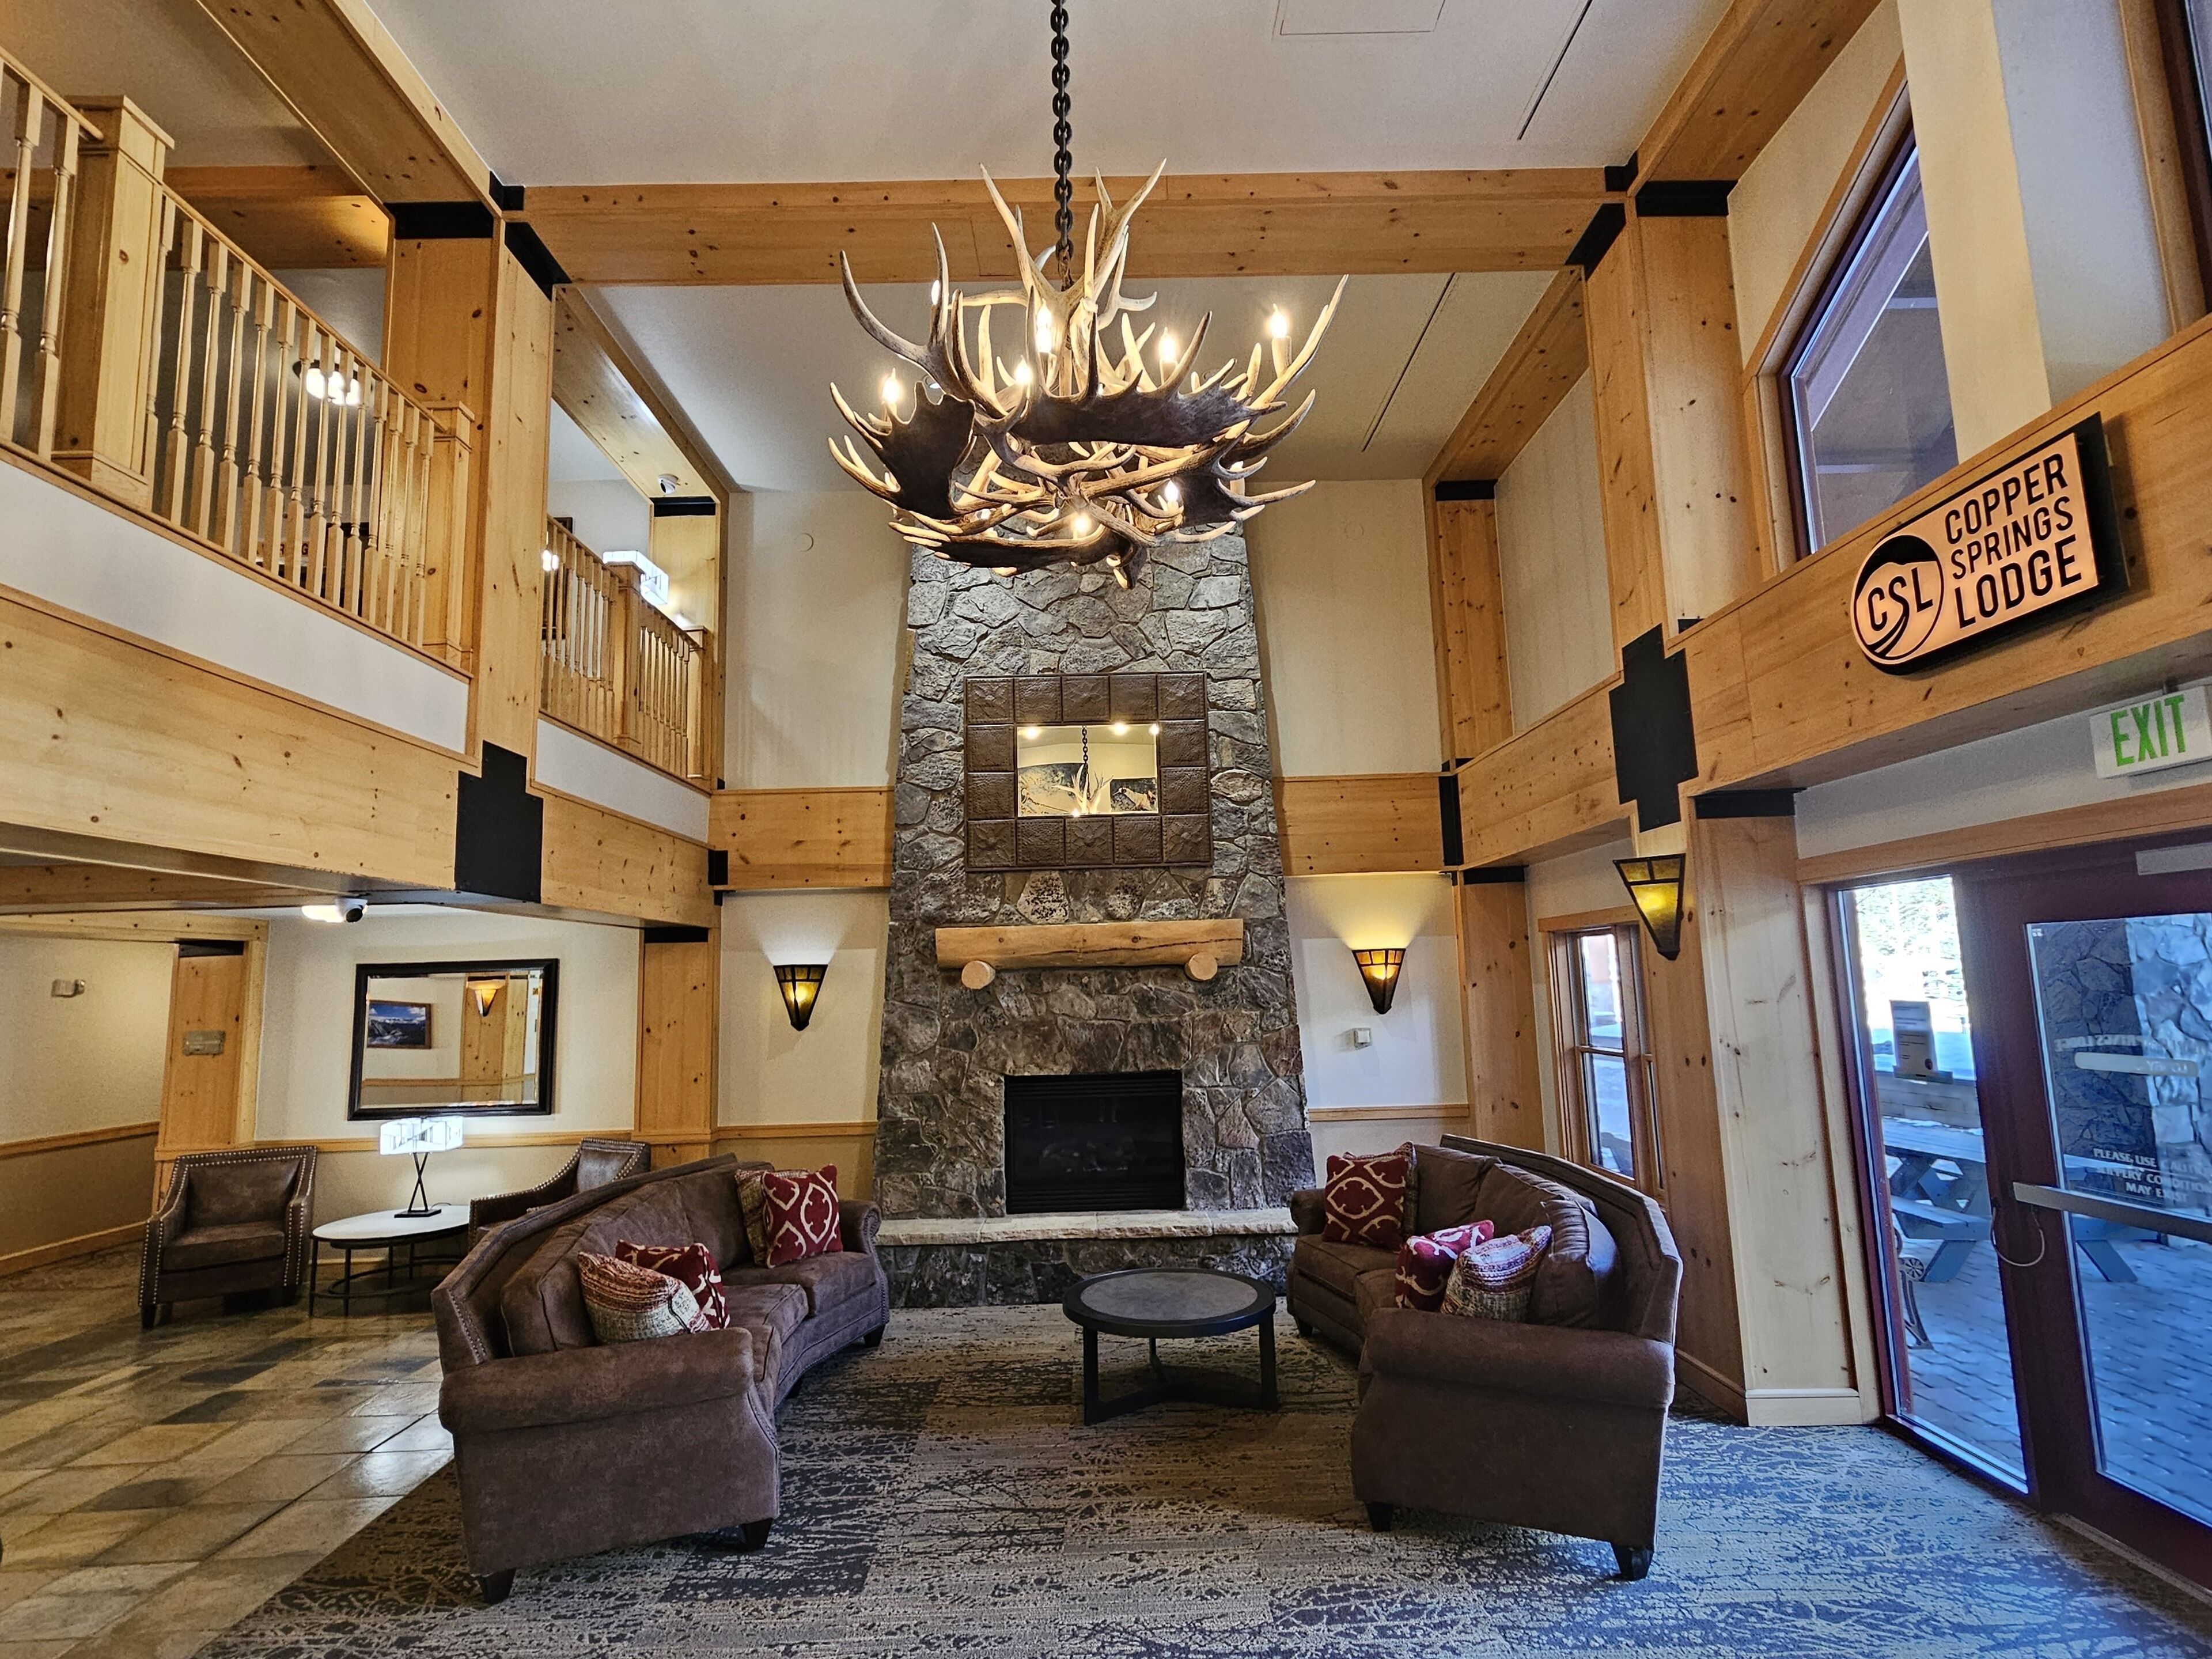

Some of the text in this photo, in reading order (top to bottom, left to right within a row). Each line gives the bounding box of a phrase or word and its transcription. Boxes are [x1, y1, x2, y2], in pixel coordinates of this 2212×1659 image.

[1945, 453, 2068, 544] COPPER
[1950, 496, 2073, 579] SPRINGS
[1868, 567, 1933, 637] CSL
[1955, 534, 2082, 628] LODGE
[2110, 694, 2186, 767] EXIT
[2093, 1148, 2134, 1163] PLEASE
[2135, 1155, 2157, 1168] USE
[2126, 1182, 2152, 1196] MAY
